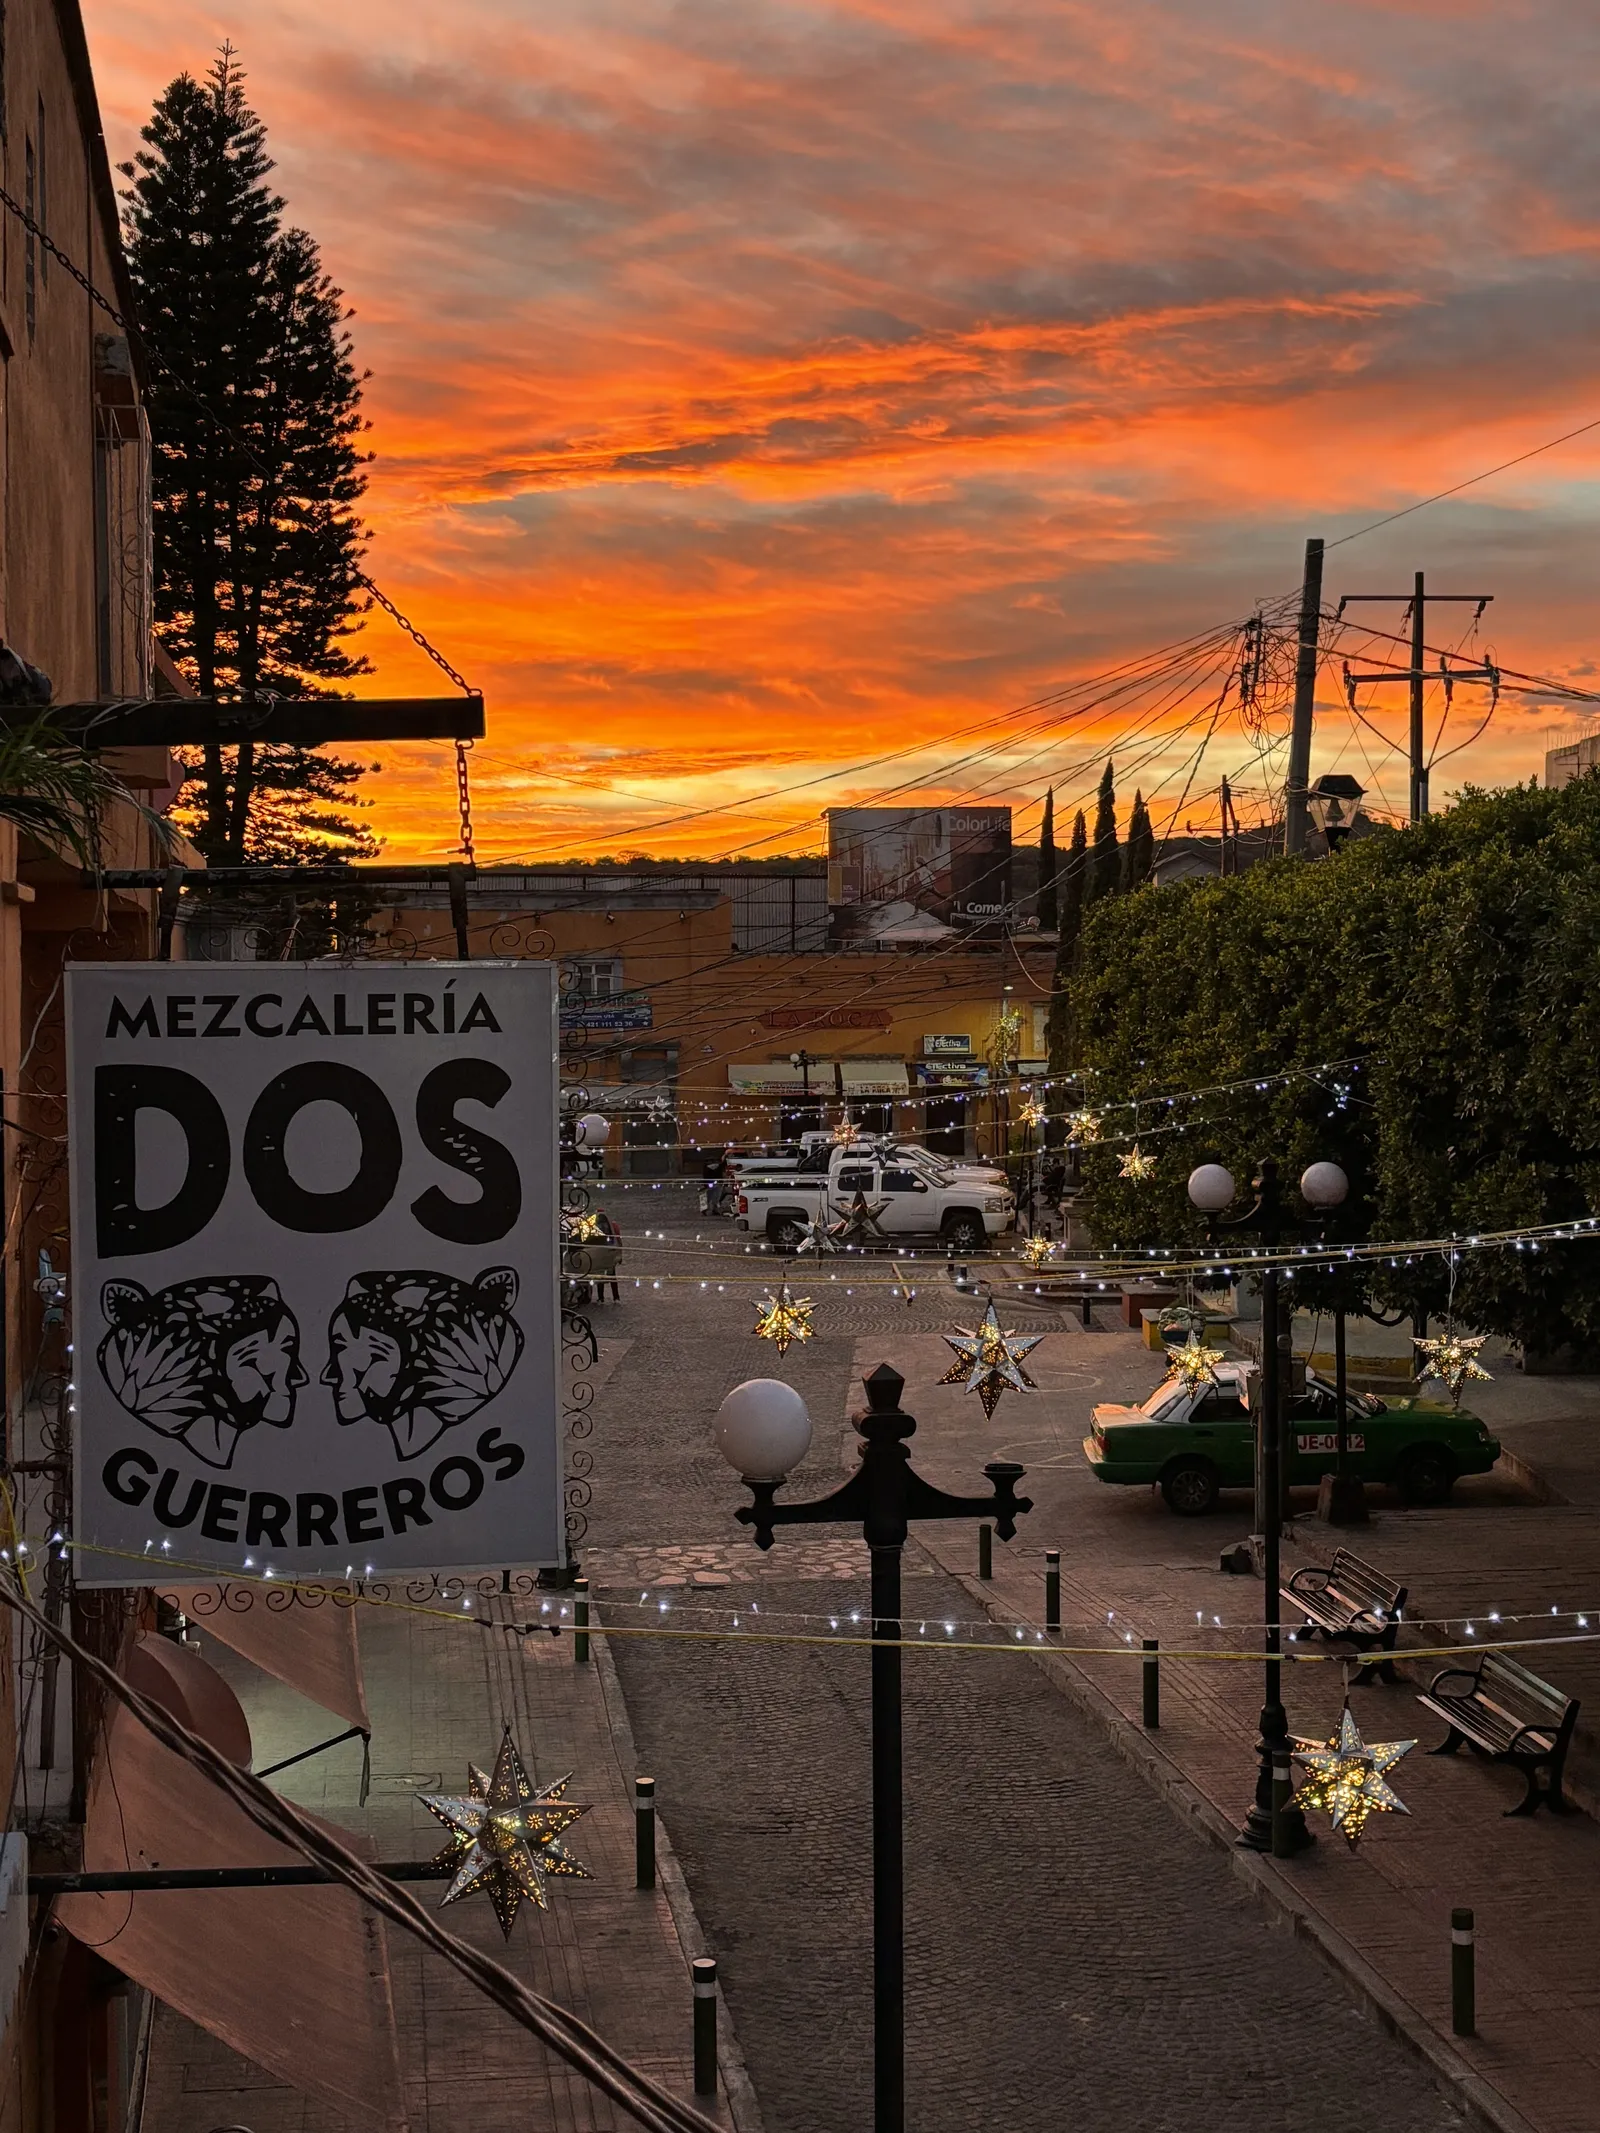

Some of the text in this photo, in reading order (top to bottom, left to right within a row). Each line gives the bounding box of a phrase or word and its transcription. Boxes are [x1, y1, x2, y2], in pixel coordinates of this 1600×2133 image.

[105, 978, 503, 1038] MEZCALERÍA
[767, 1011, 887, 1027] LA ROCA
[94, 1057, 522, 1260] DOS
[102, 1427, 526, 1549] GUERREROS
